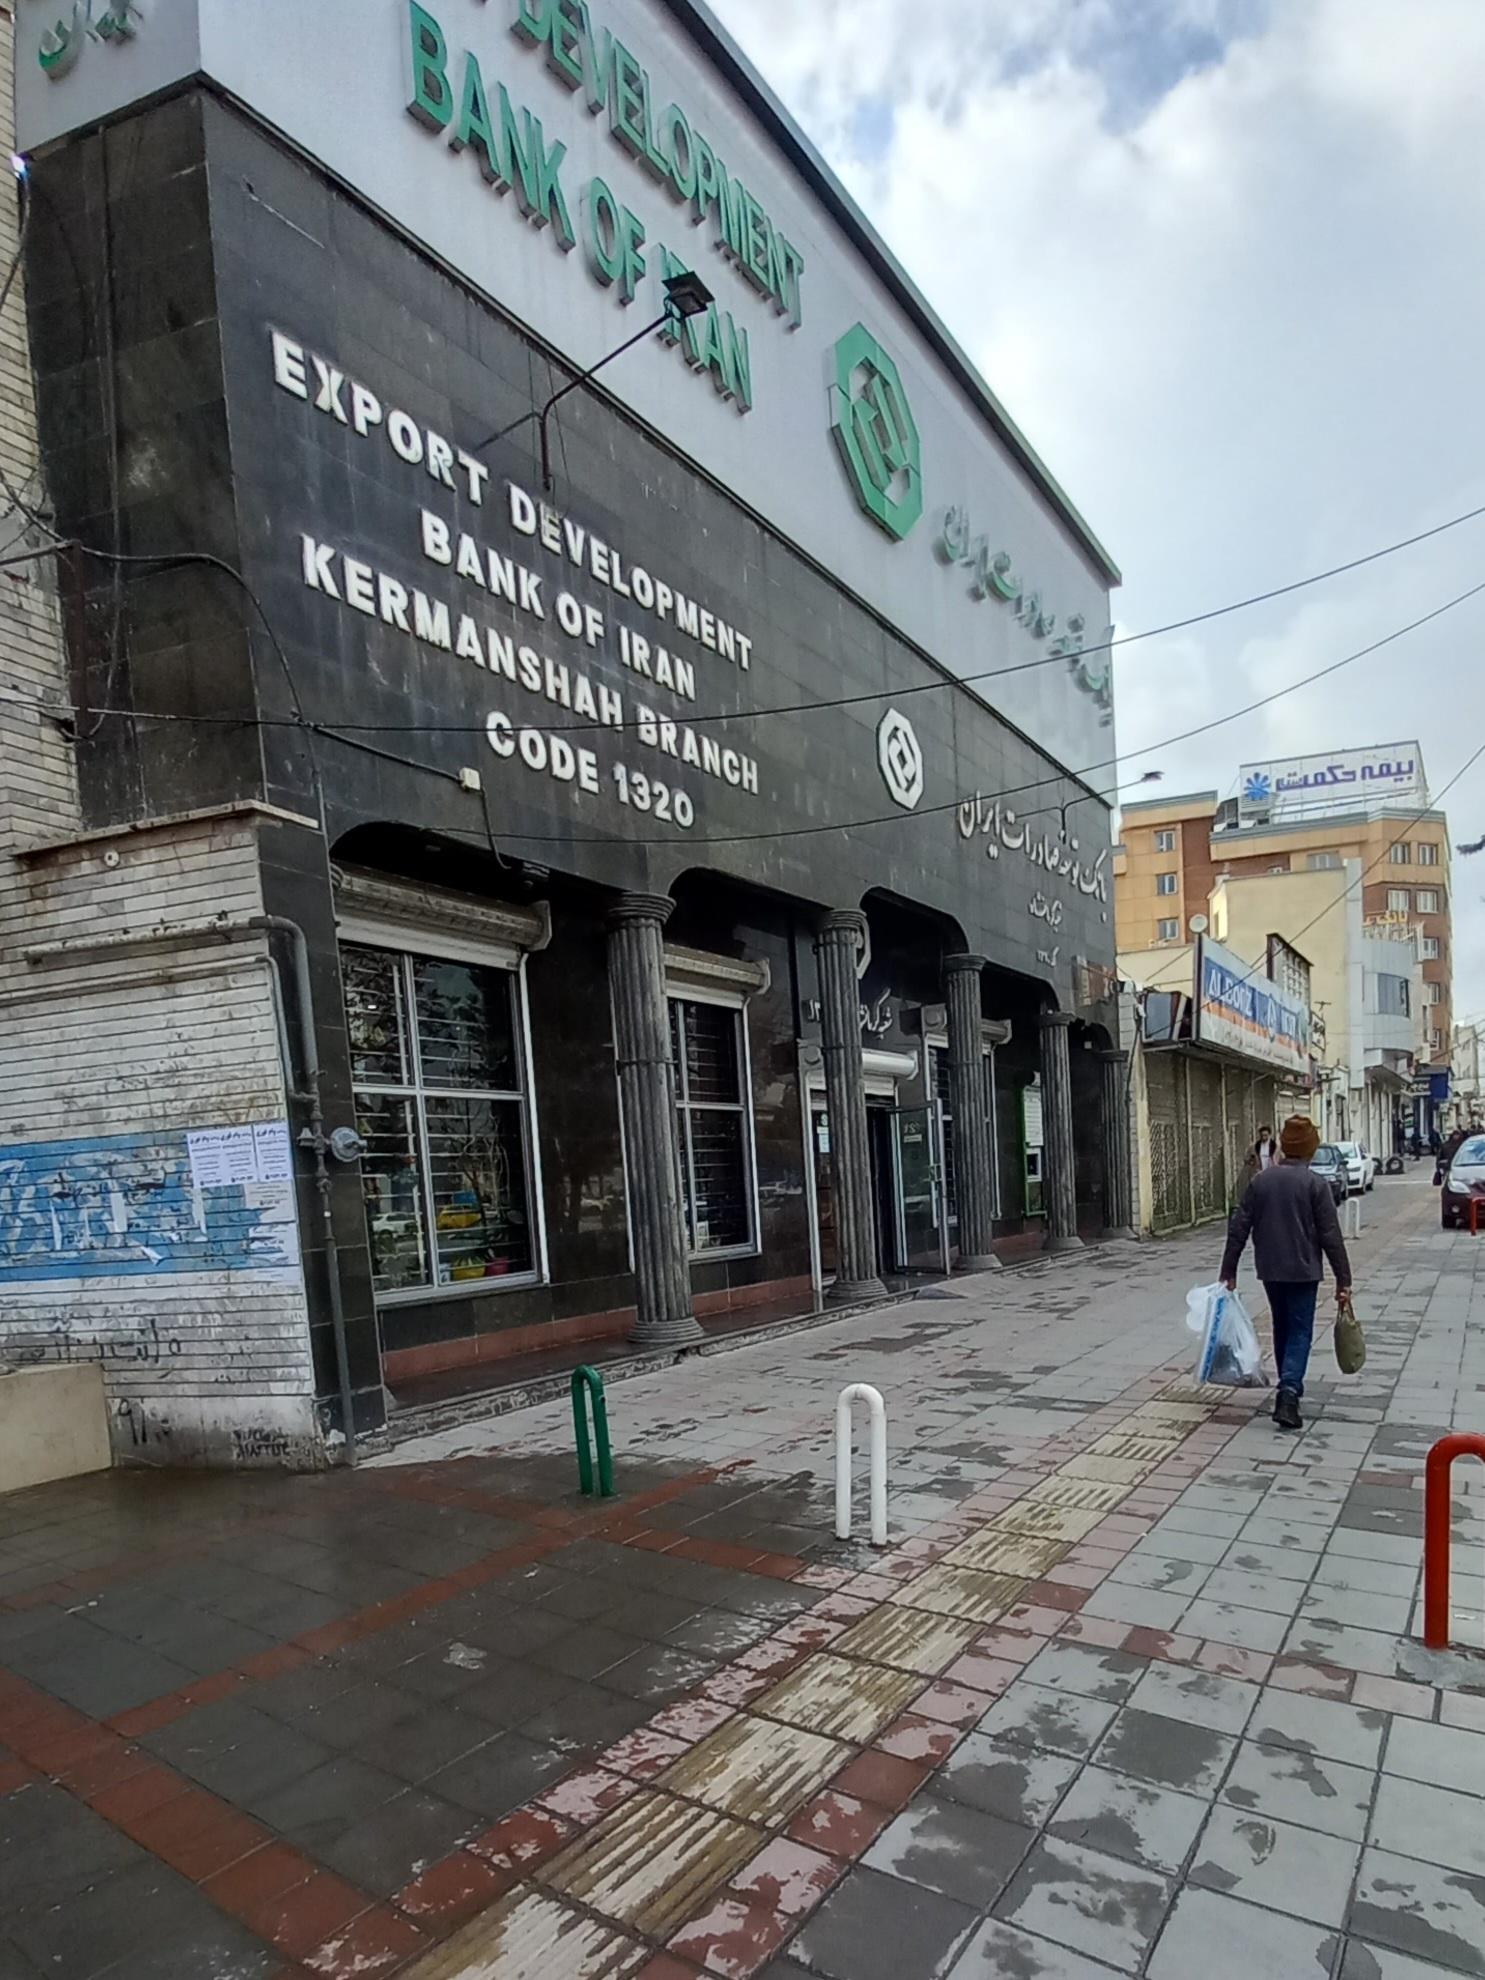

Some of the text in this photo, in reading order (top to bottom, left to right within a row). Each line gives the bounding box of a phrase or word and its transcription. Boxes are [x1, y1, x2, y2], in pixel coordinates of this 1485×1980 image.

[407, 1, 575, 253] BANK
[580, 177, 645, 306] OF
[269, 329, 752, 671] EXPORT DEVELOPMENT
[421, 508, 696, 700] BANK OF IRAN
[301, 533, 759, 795] KERMANSHAH BRANCH
[485, 711, 695, 829] CODE 1320
[959, 789, 1001, 860] ایران
[1361, 759, 1414, 783] بیمه
[1001, 809, 1059, 871] صادرات
[1079, 848, 1108, 923] بانک
